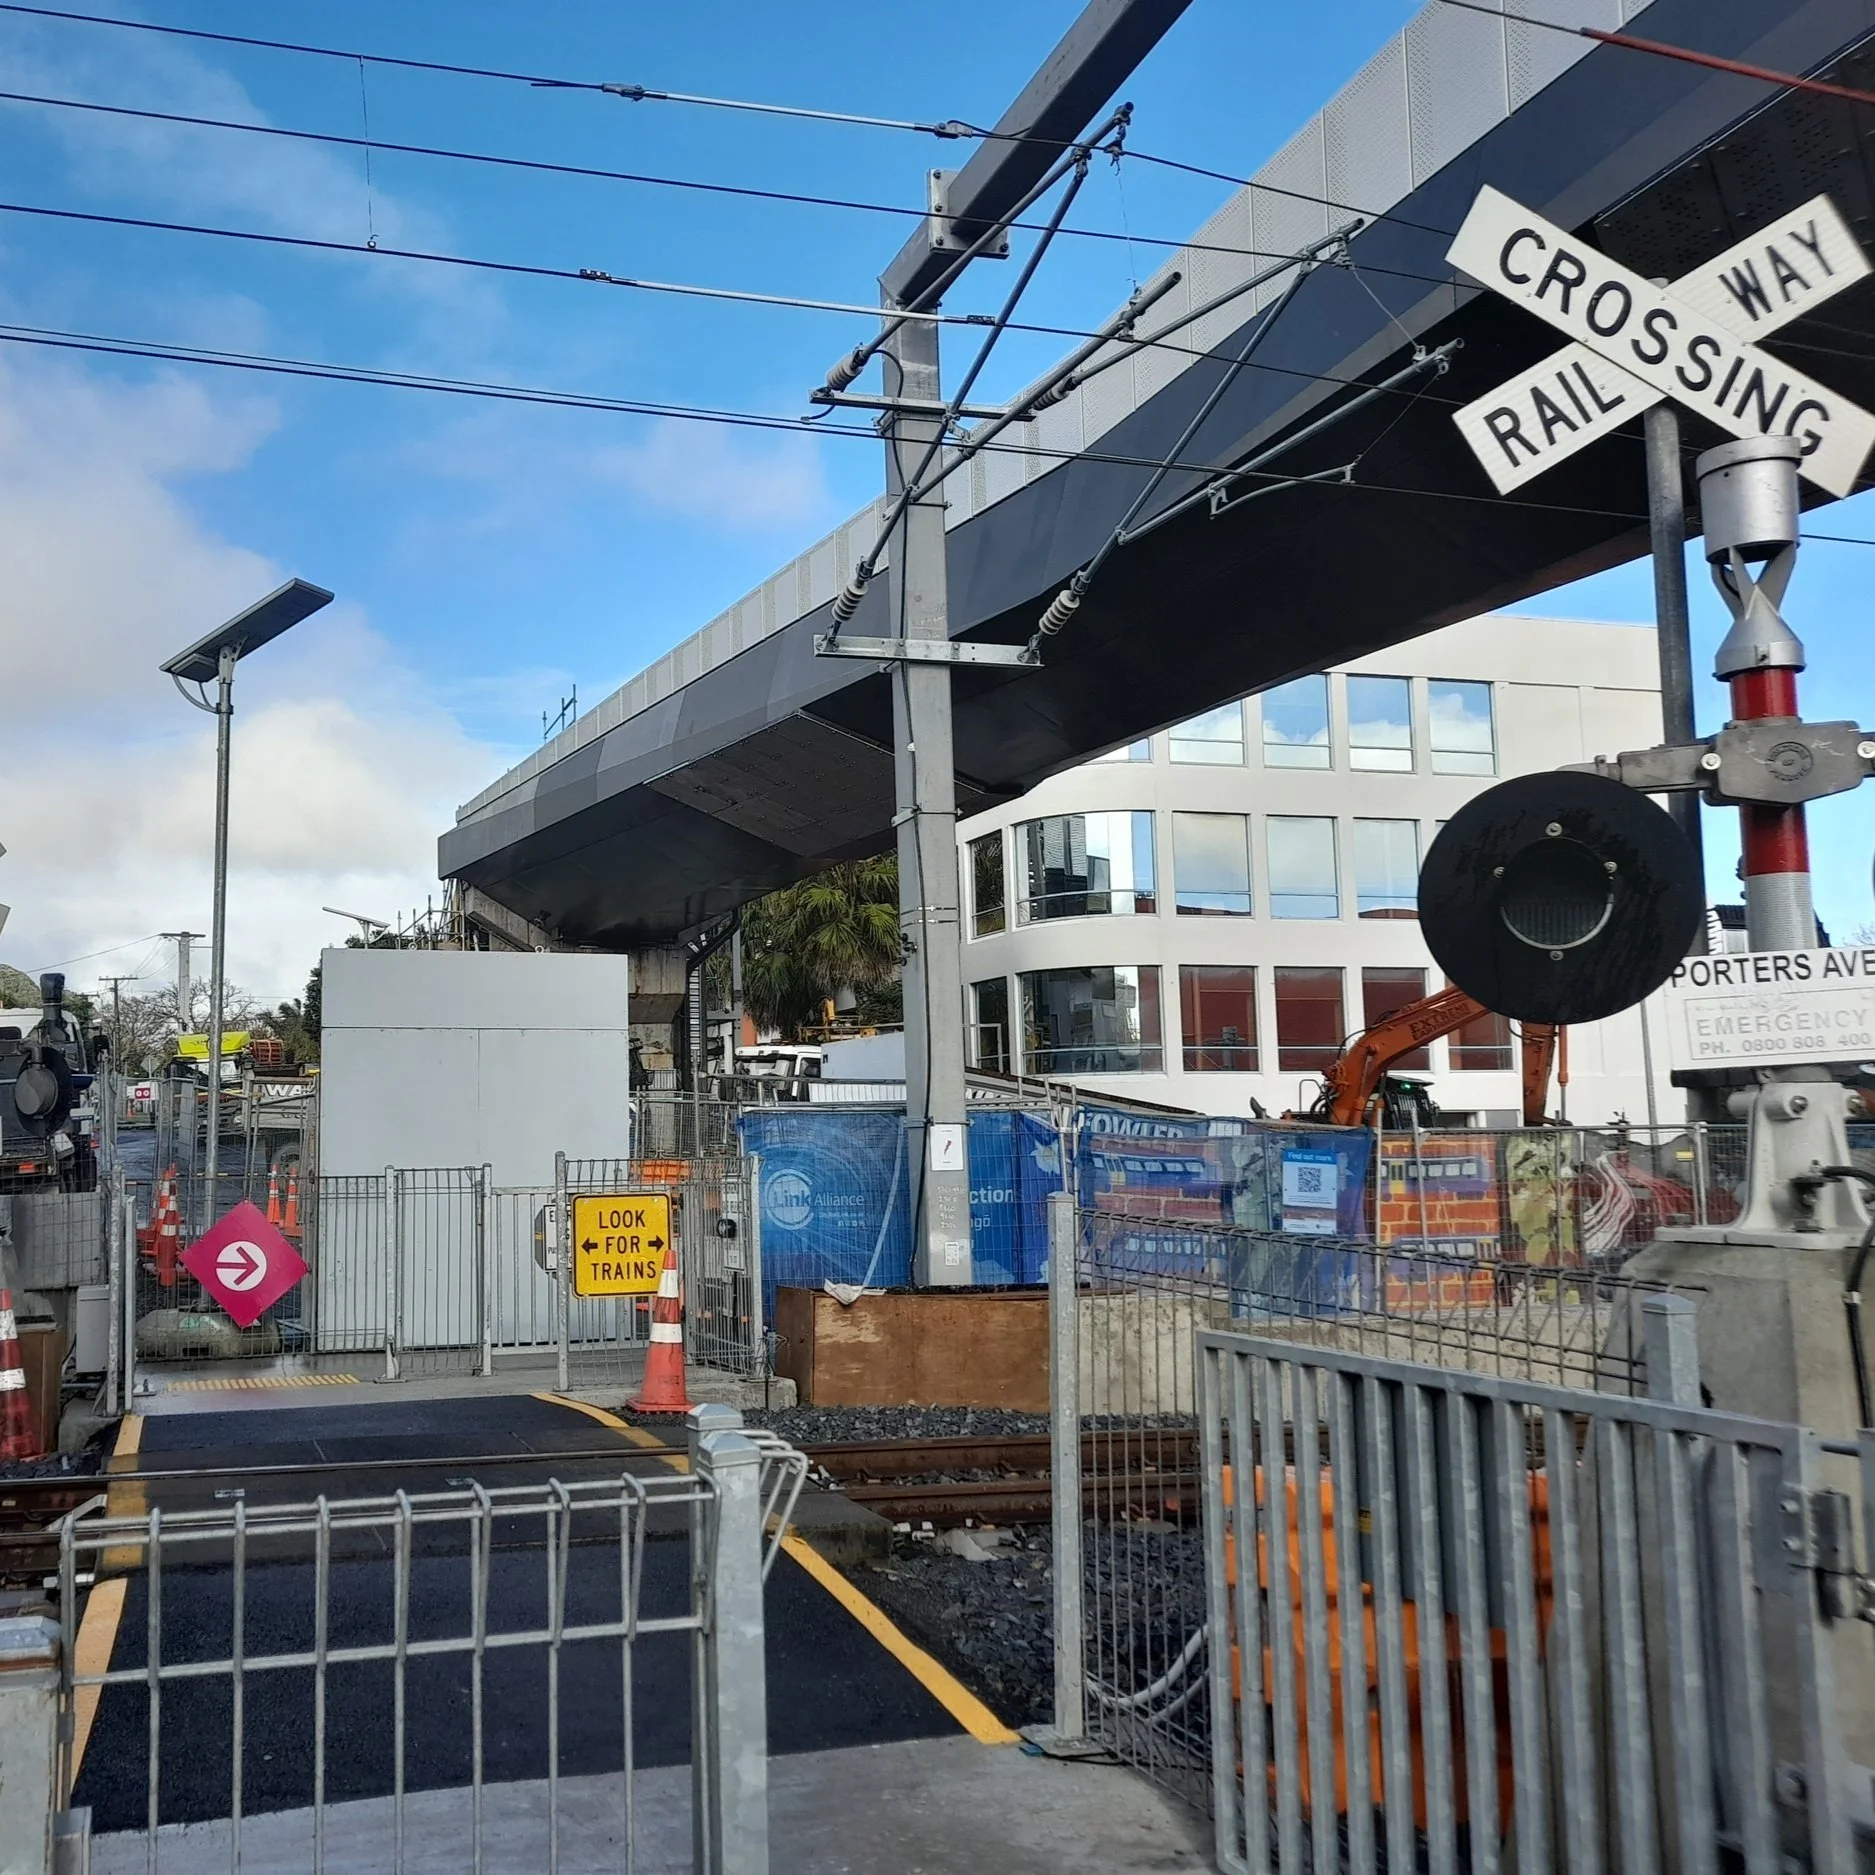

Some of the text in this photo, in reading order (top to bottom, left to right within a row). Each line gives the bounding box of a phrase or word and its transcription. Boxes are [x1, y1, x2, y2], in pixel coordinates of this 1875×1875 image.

[1483, 219, 1836, 468] RAIL WAY
[1499, 228, 1830, 457] CROSSING
[1671, 950, 1875, 988] PORTERS AVE
[1696, 1008, 1867, 1036] EMERGENCY
[1742, 1038, 1786, 1052] 0800
[1837, 1032, 1871, 1047] 400
[813, 1191, 865, 1206] Alliance
[598, 1209, 646, 1229] LOOK
[605, 1235, 641, 1254] FOR
[591, 1260, 657, 1281] TRAINS
